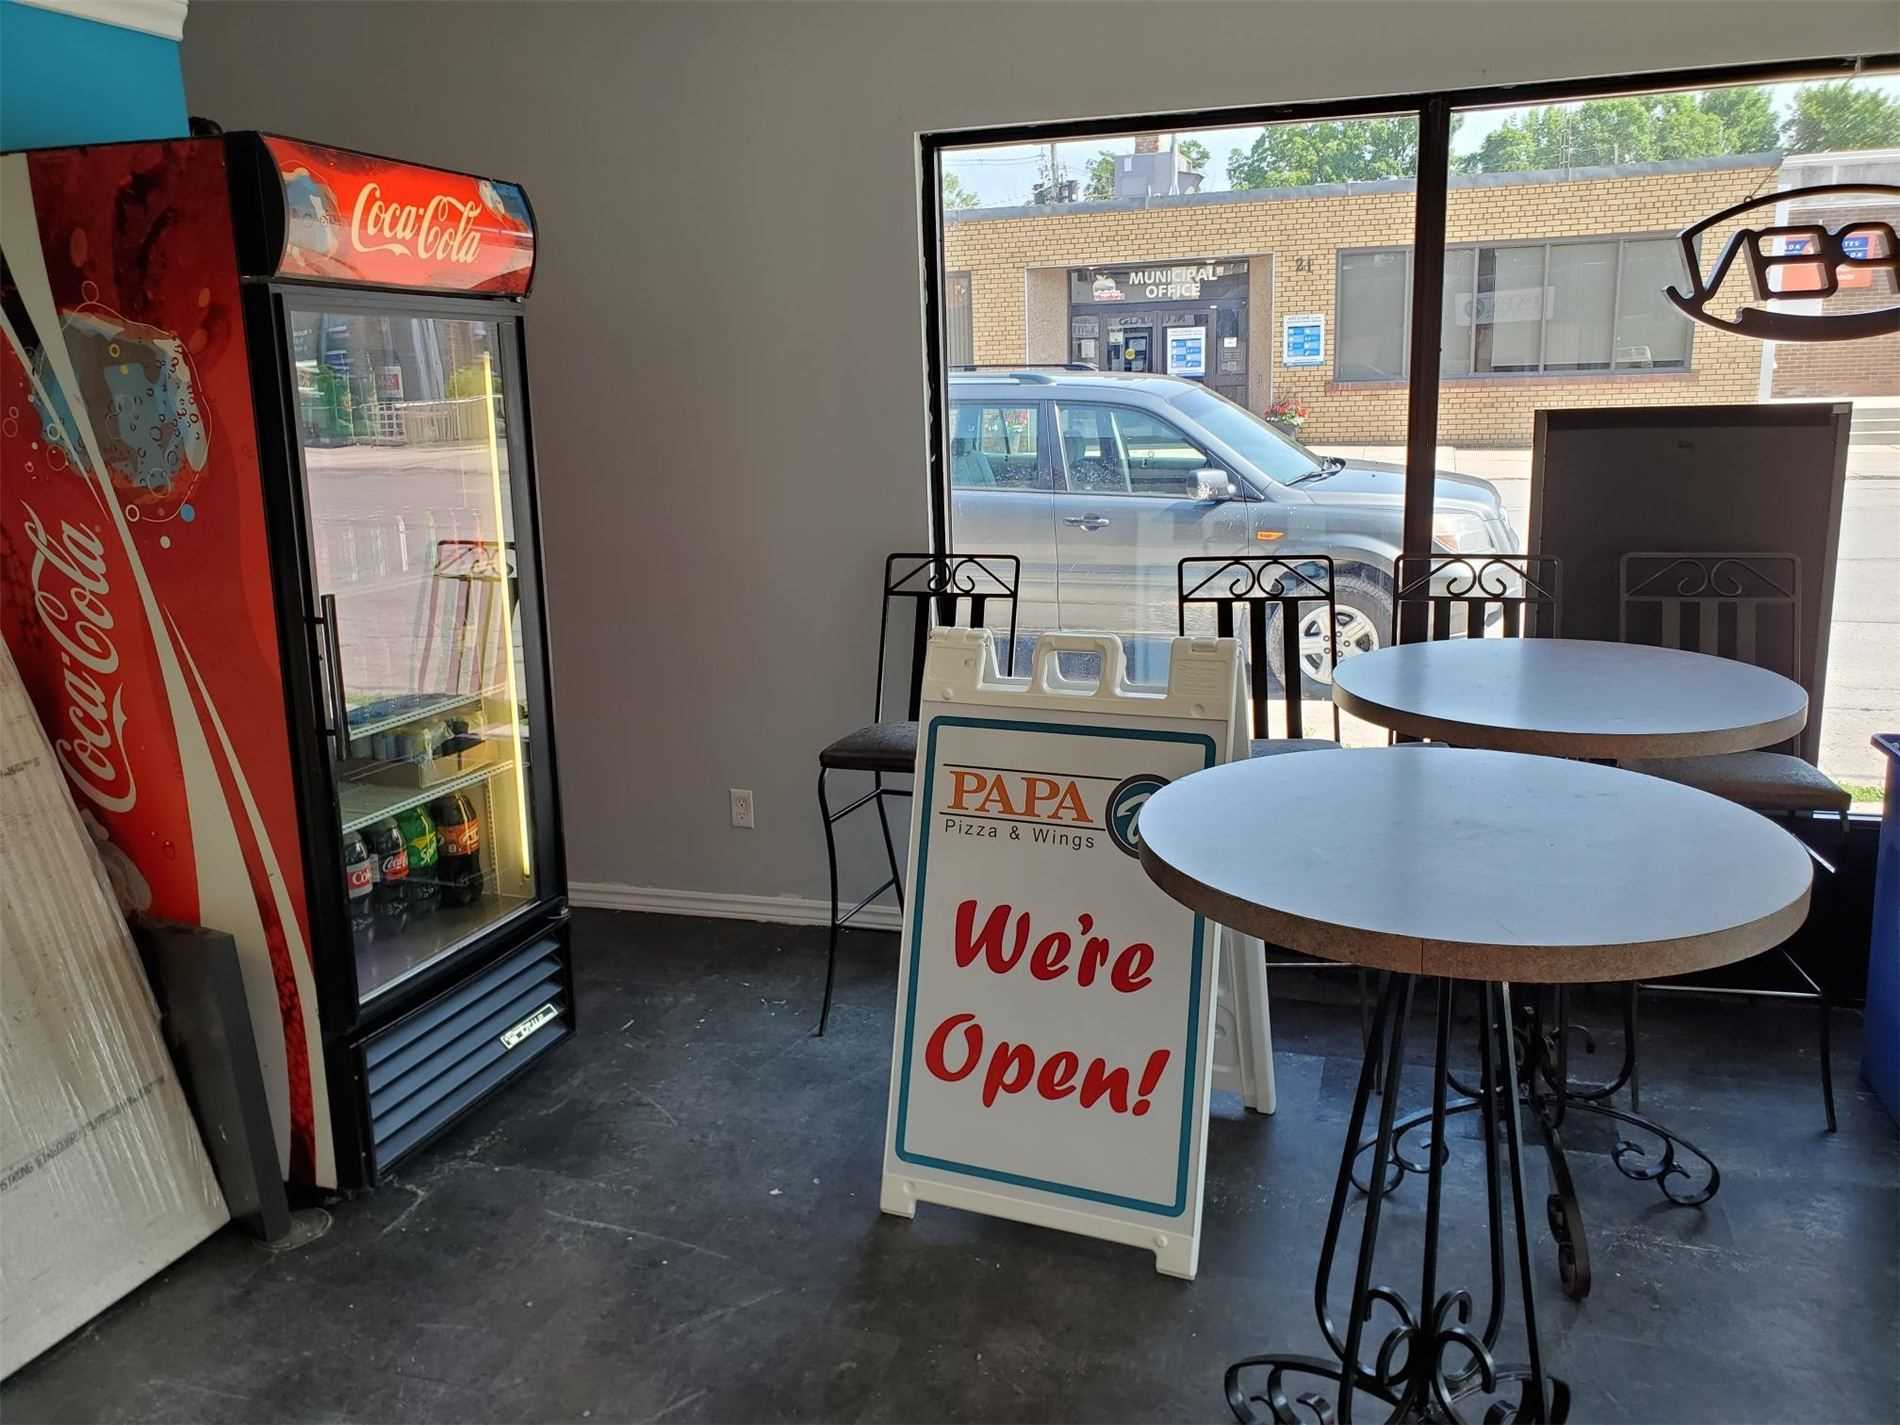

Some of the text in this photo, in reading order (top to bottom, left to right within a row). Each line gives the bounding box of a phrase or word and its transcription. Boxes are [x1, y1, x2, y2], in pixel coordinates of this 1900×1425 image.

[352, 182, 483, 264] Coca-Cola
[1129, 264, 1218, 285] MUNICIPAL
[1145, 282, 1200, 299] OFFICE
[1296, 258, 1311, 272] 21
[20, 499, 137, 813] Coca-Cola
[947, 770, 1094, 824] PAPA
[945, 818, 1096, 851] Pizza & Wings
[955, 899, 1155, 994] We're
[925, 1013, 1171, 1117] Open!
